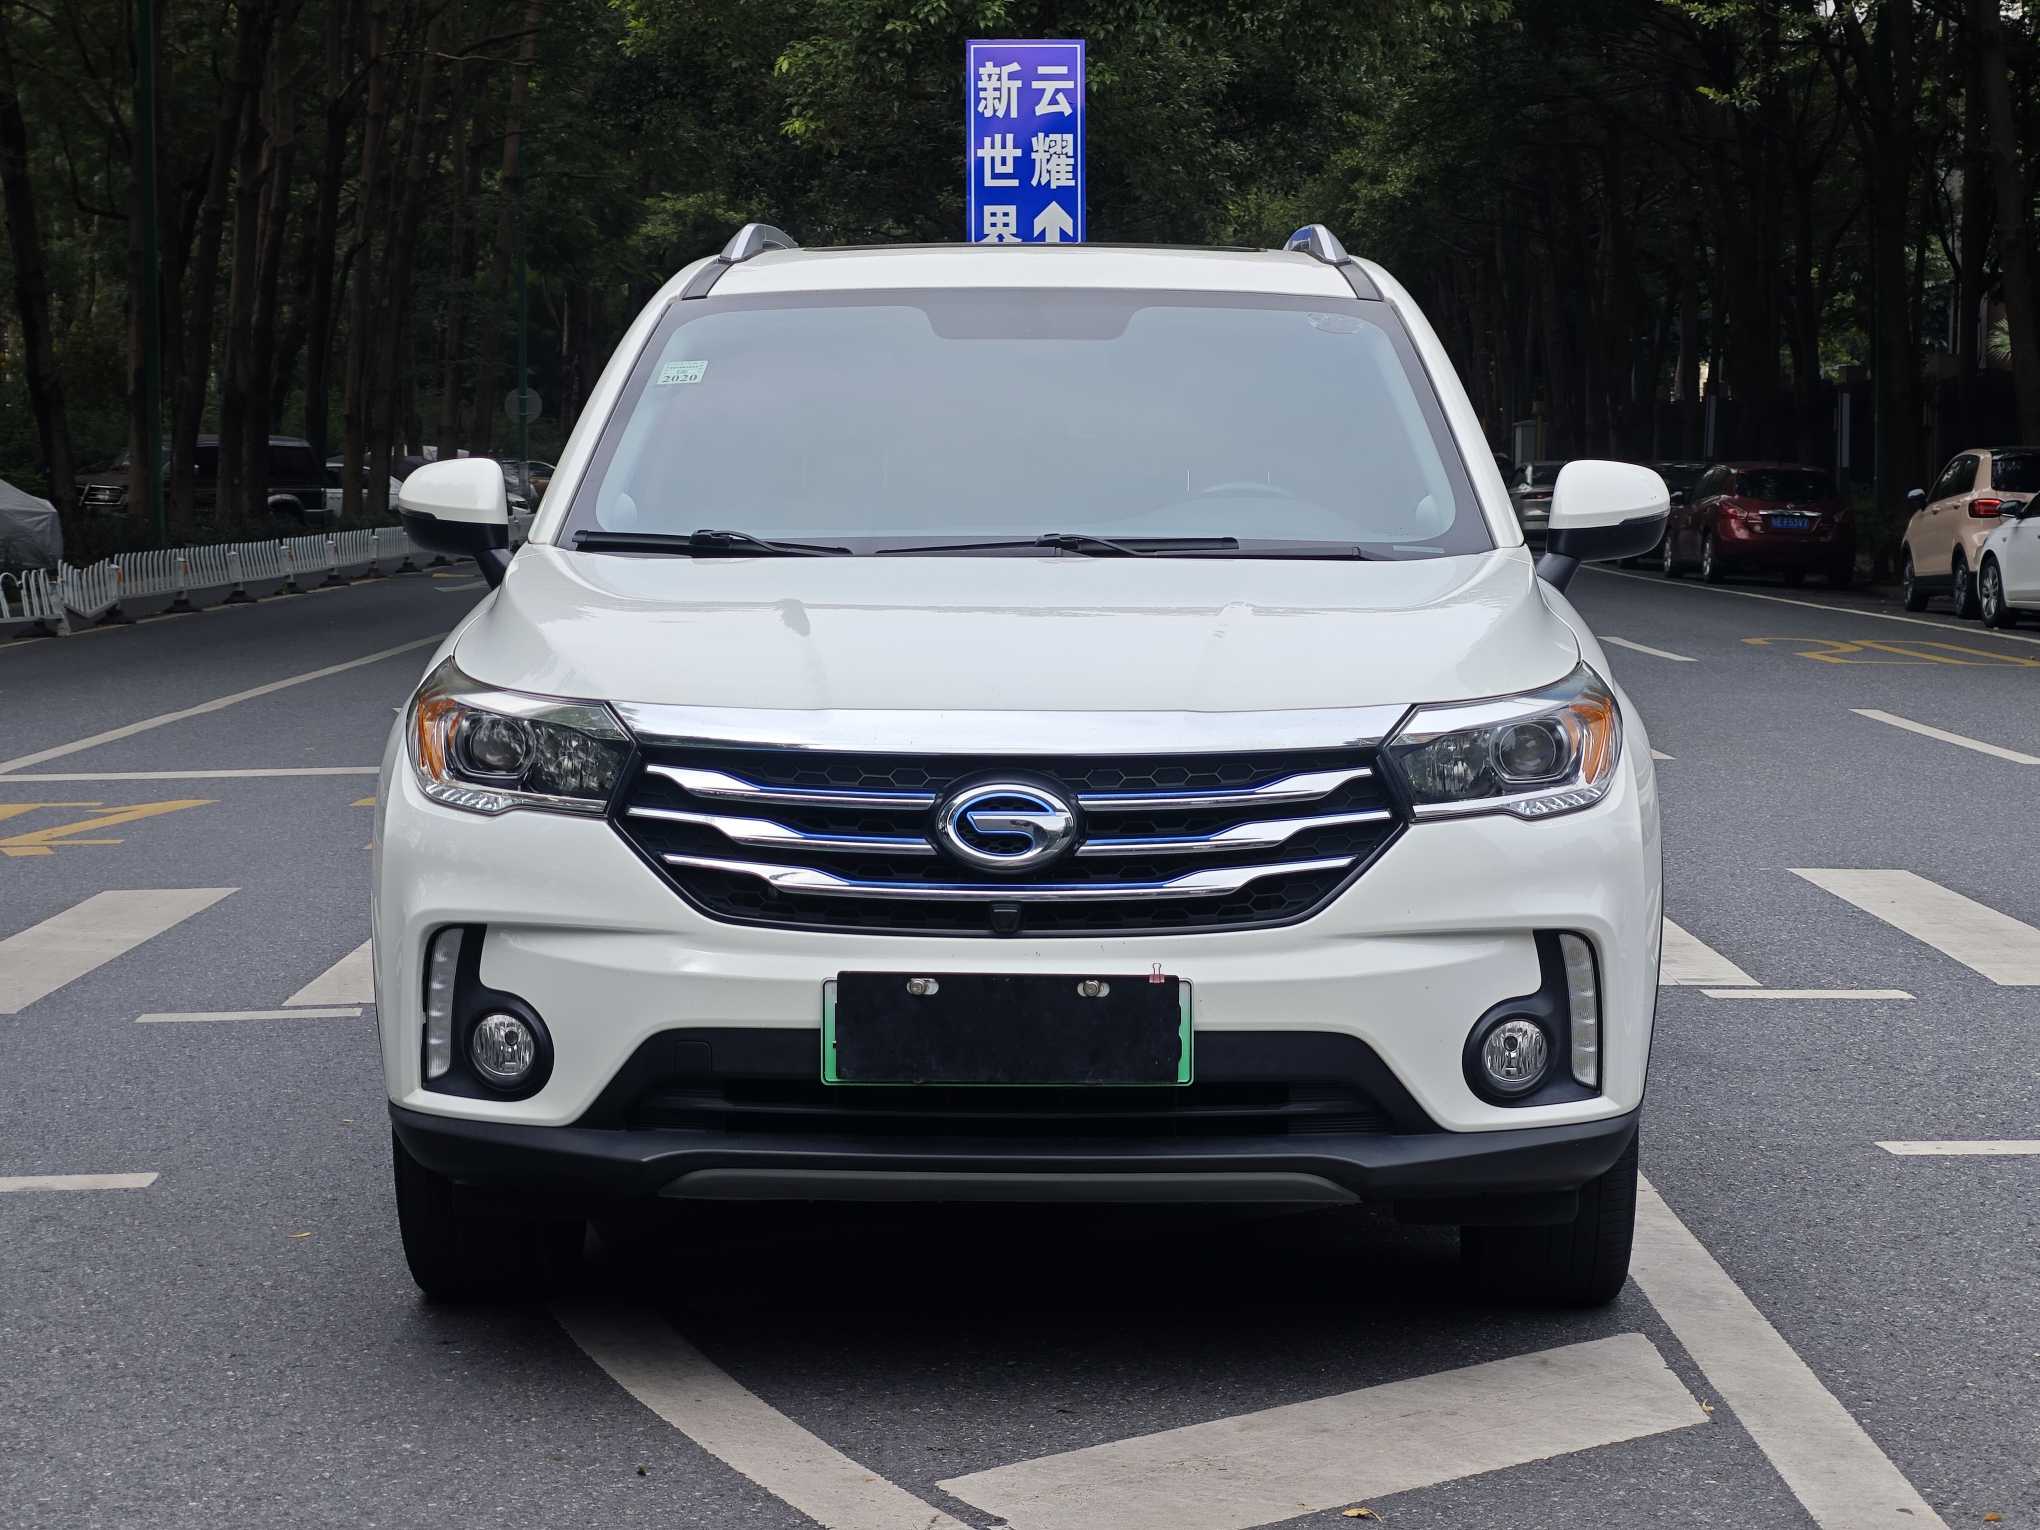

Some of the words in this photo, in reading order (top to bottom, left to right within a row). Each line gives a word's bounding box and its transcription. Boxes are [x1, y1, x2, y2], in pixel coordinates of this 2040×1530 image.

[976, 61, 1023, 243] 新世界
[1030, 65, 1076, 190] 云耀
[662, 374, 699, 383] 2020
